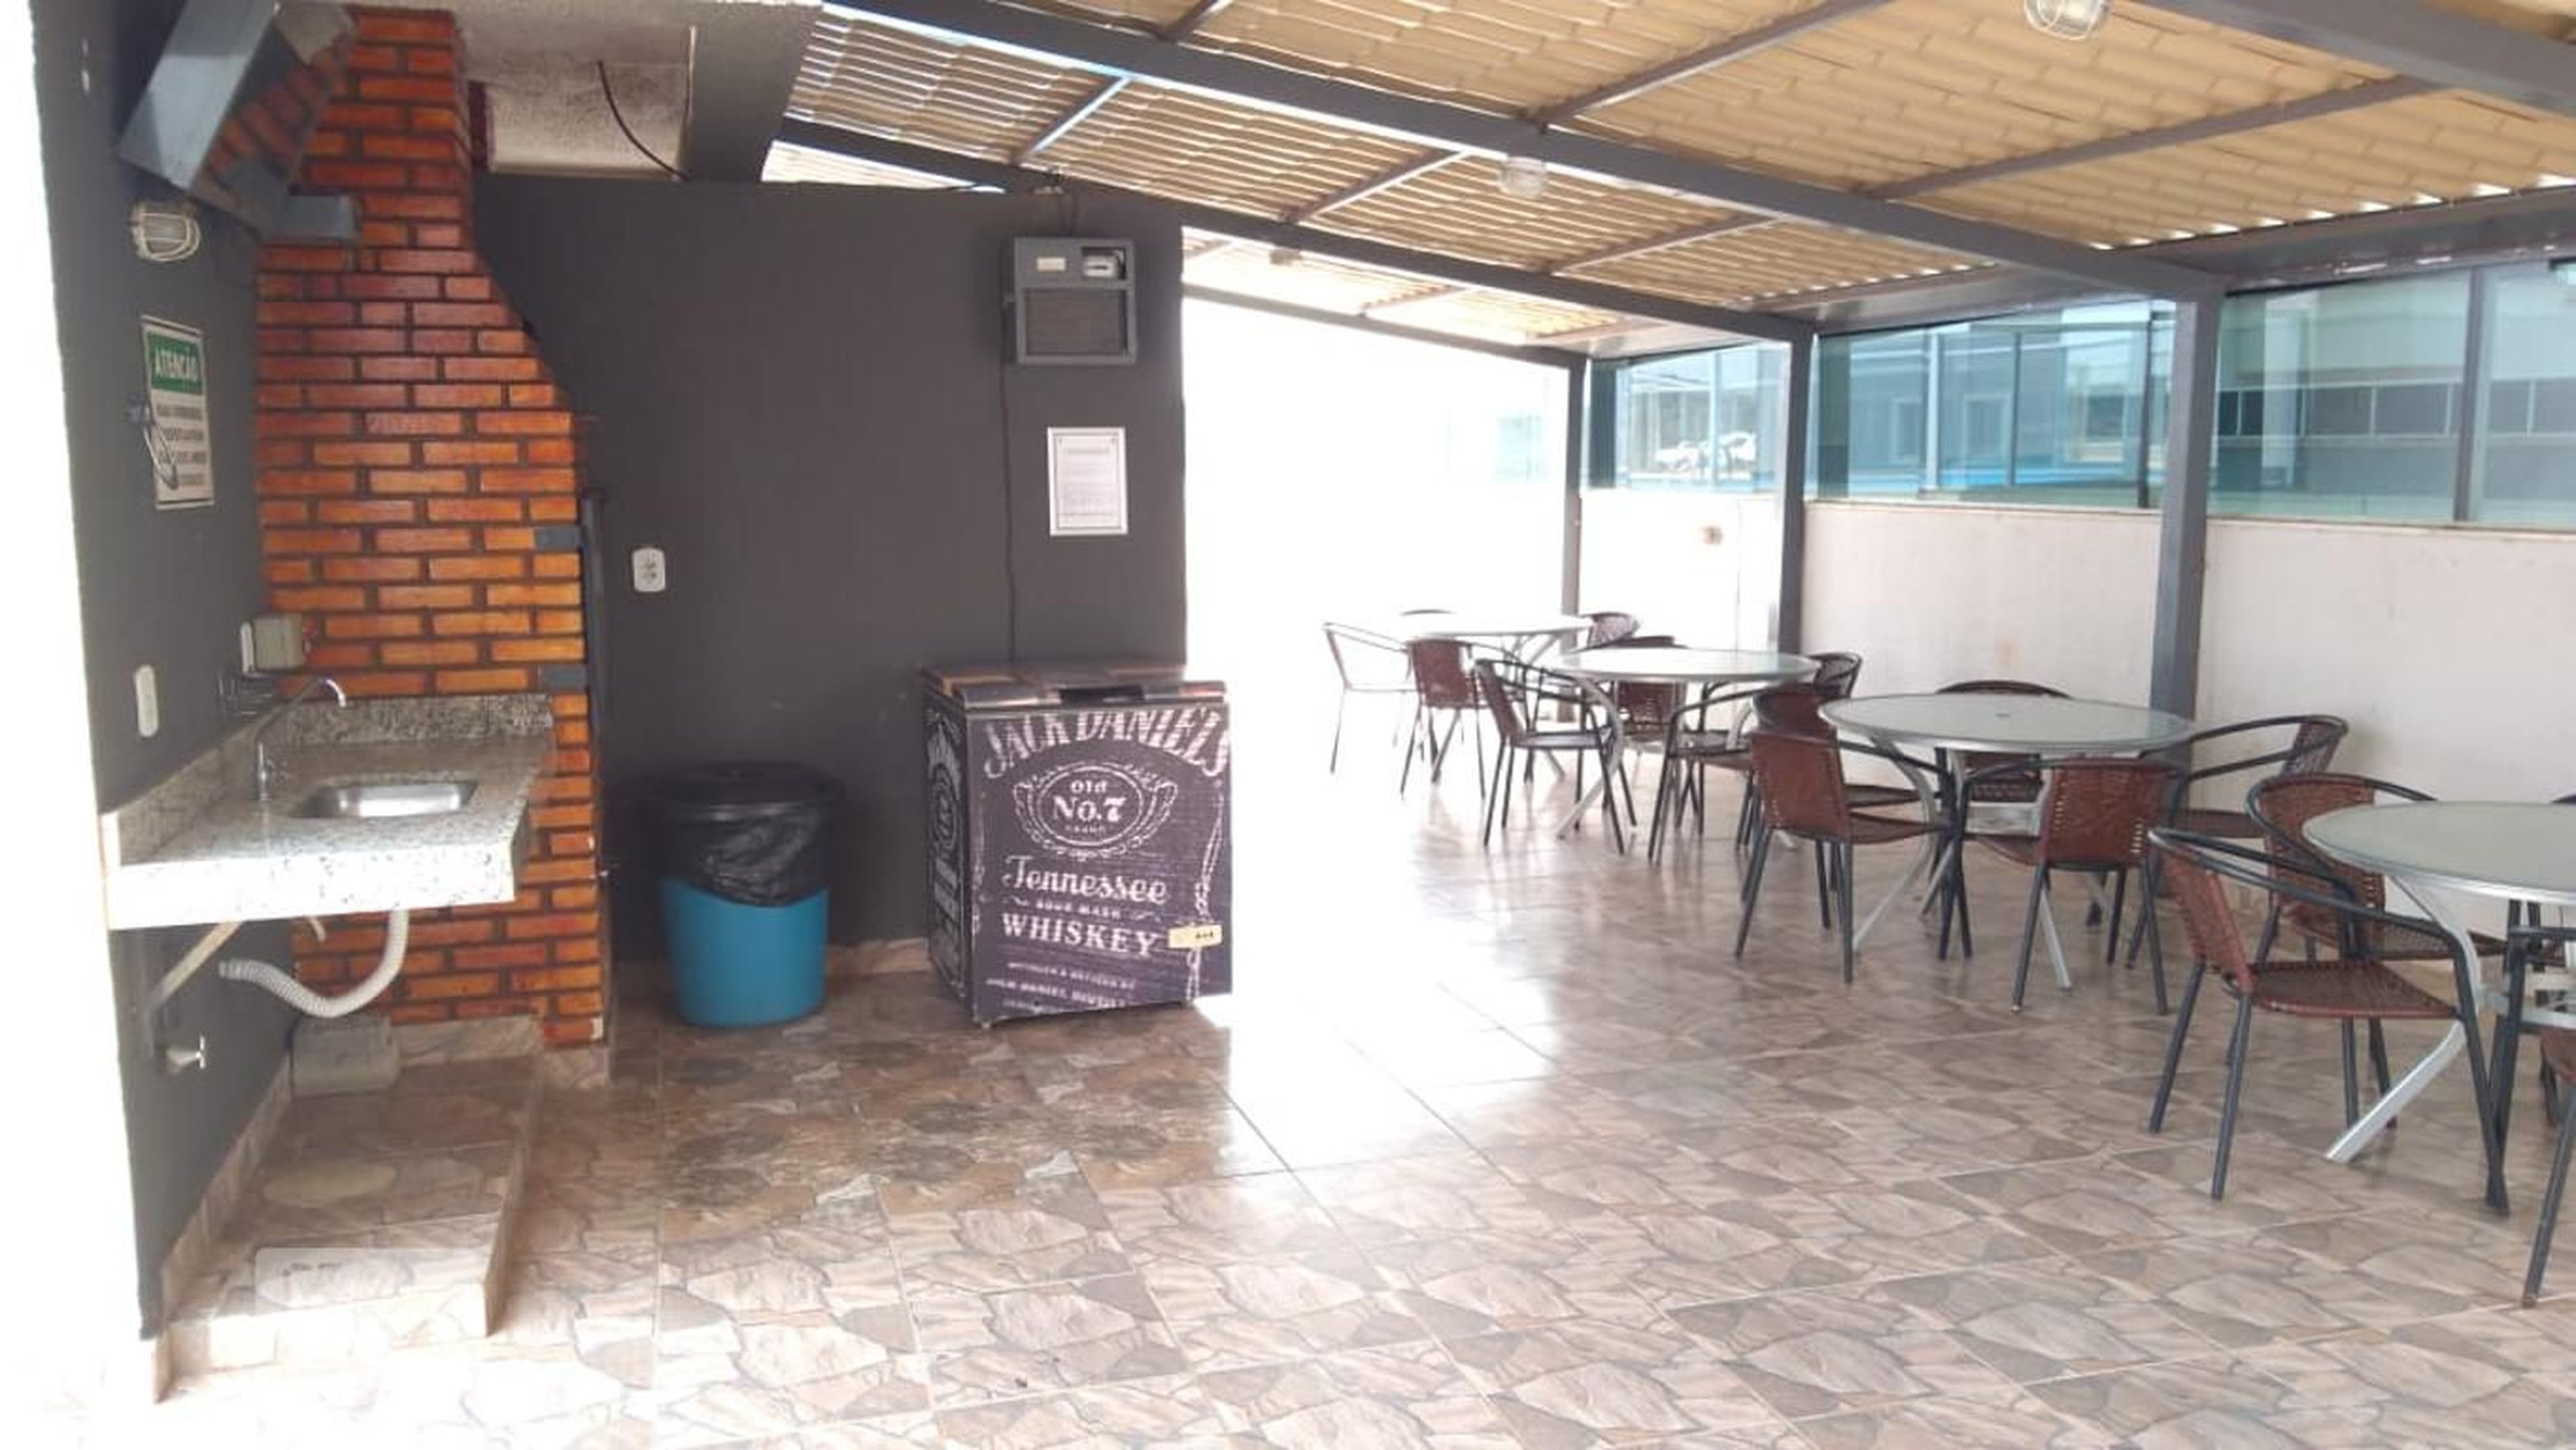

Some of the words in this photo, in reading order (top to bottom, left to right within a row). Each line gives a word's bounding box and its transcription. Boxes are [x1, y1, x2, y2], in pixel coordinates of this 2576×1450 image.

[984, 713, 1071, 779] JACK
[1002, 854, 1167, 905] Tennessee
[1002, 913, 1161, 958] WHISKEY
